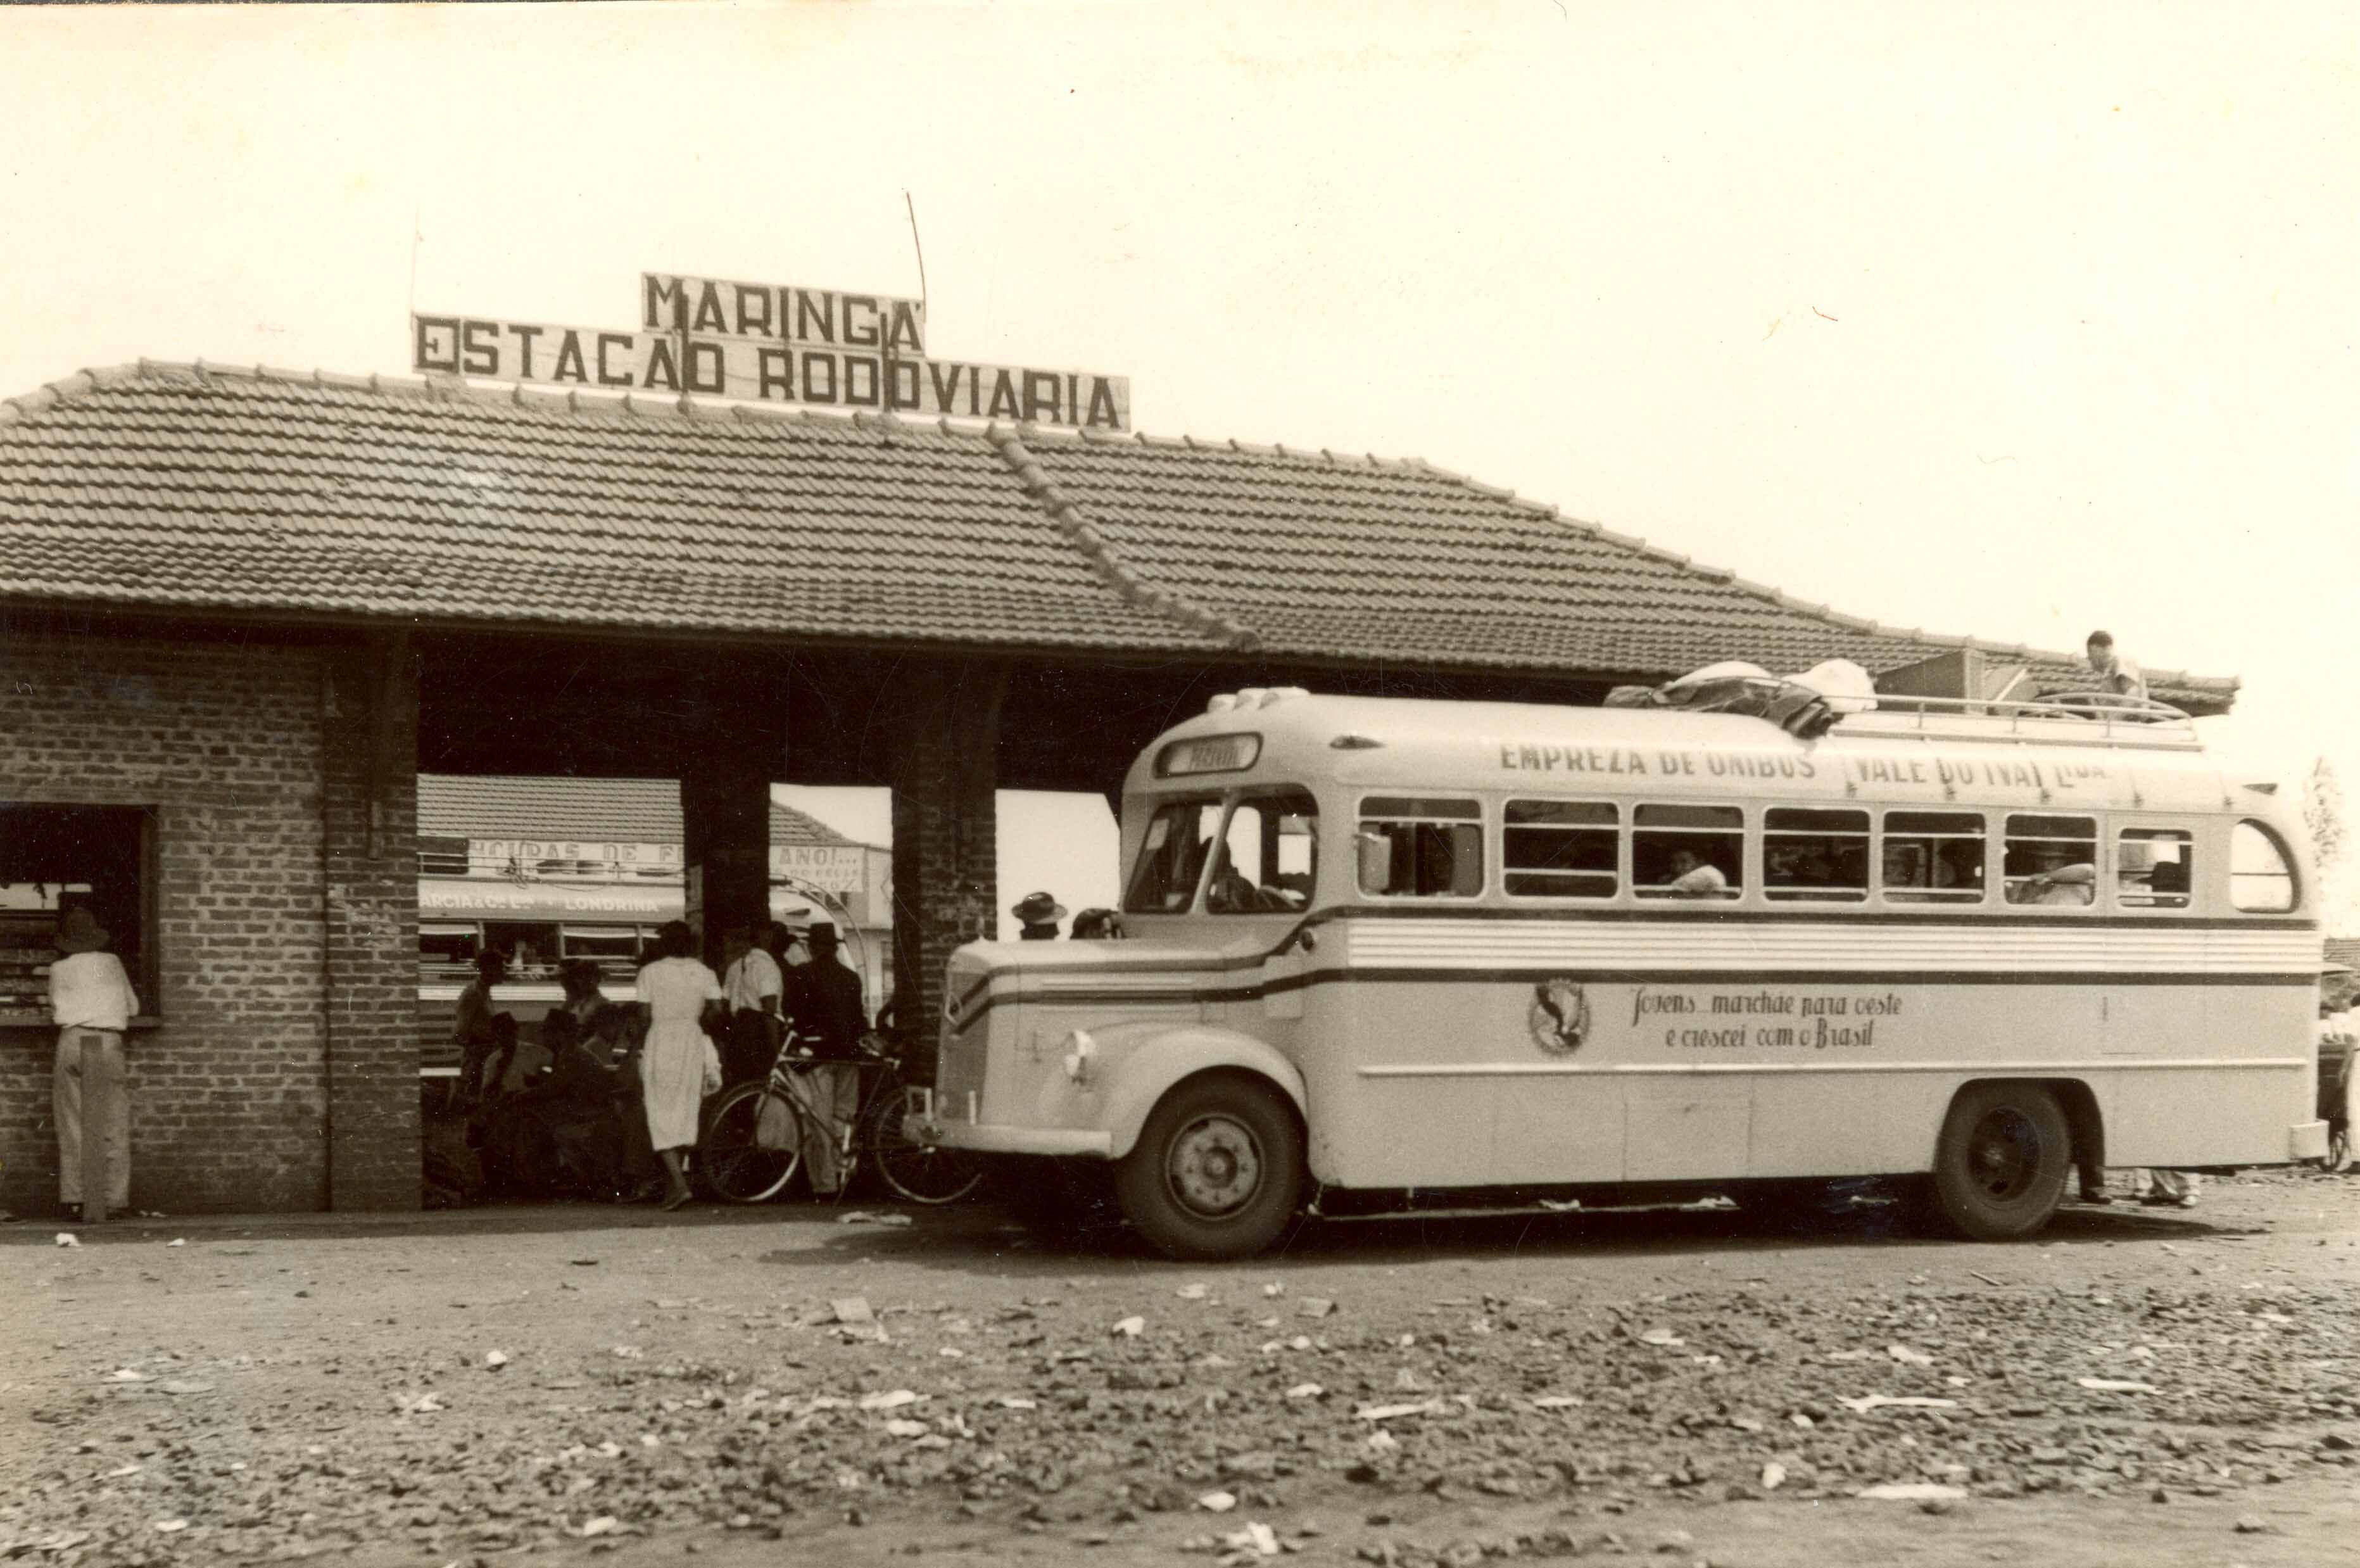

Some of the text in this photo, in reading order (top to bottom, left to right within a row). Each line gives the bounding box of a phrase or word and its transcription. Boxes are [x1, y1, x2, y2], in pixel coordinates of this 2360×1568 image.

[644, 275, 922, 351] MARINGÁ
[417, 315, 1121, 429] ESTACAO RODOVIARIA
[1499, 744, 1646, 775] EMPREZA
[1658, 750, 1696, 775] DE
[1856, 758, 1927, 783] VALE
[564, 896, 660, 912] LONDRINA
[1801, 996, 1847, 1018] para
[1855, 992, 1902, 1015] oeste
[1665, 1017, 1875, 1049] e crescei com o Brasil
